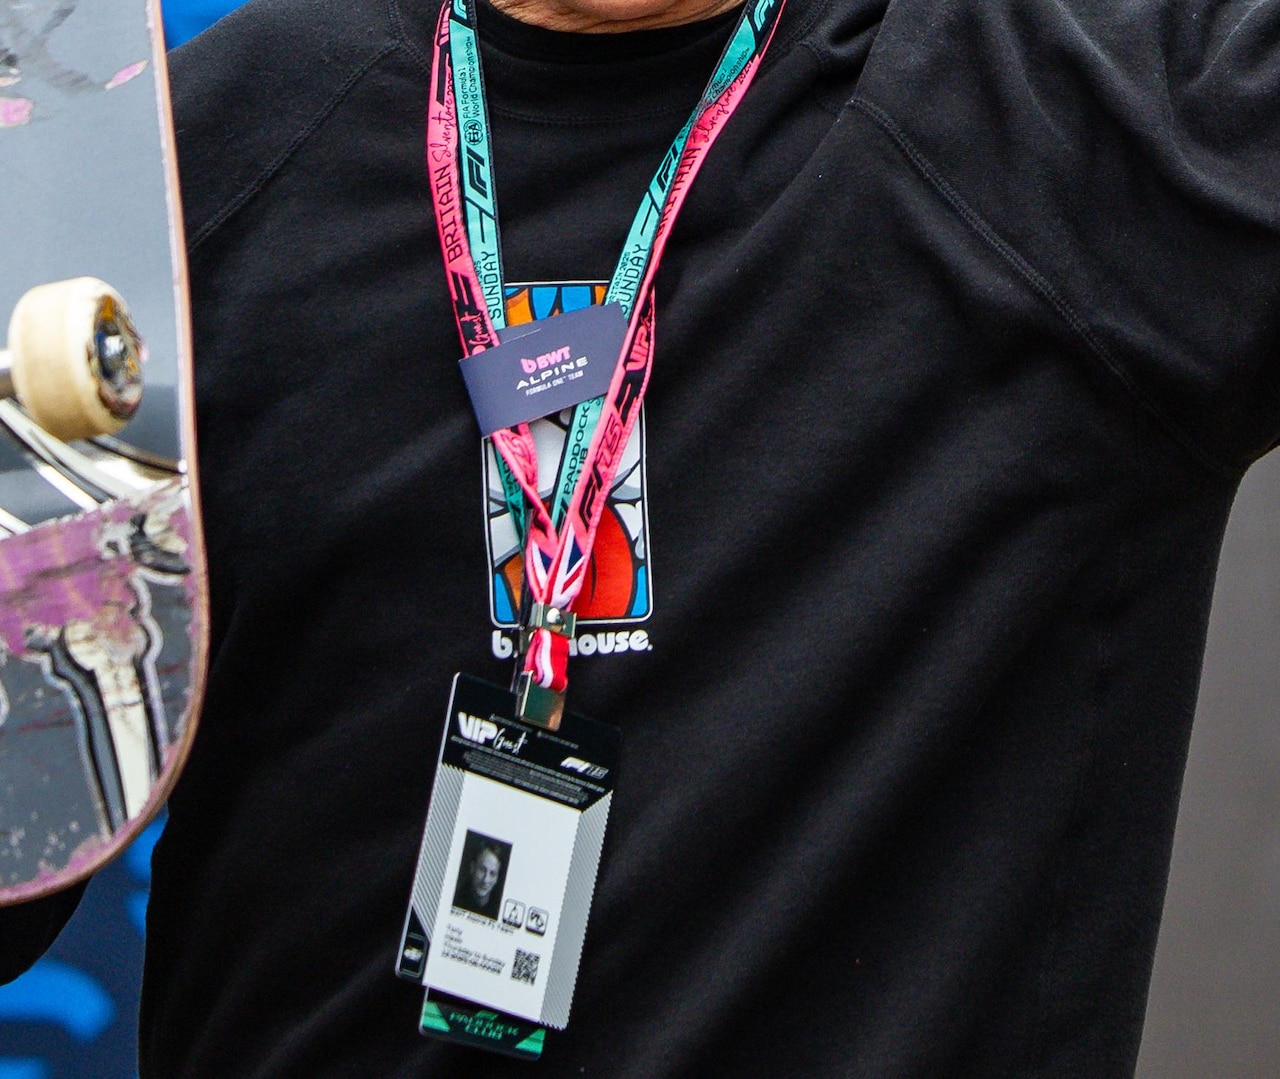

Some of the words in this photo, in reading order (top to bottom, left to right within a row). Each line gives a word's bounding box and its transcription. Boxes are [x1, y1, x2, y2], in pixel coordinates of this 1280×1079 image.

[459, 73, 471, 105] Formula
[469, 93, 481, 118] World
[466, 146, 488, 199] F1
[434, 163, 464, 264] BRITAIN
[481, 250, 503, 321] SUNDAY
[625, 325, 650, 372] VIP
[516, 356, 589, 391] ALPINE
[563, 405, 591, 496] PADDOCK
[458, 711, 498, 745] VIP
